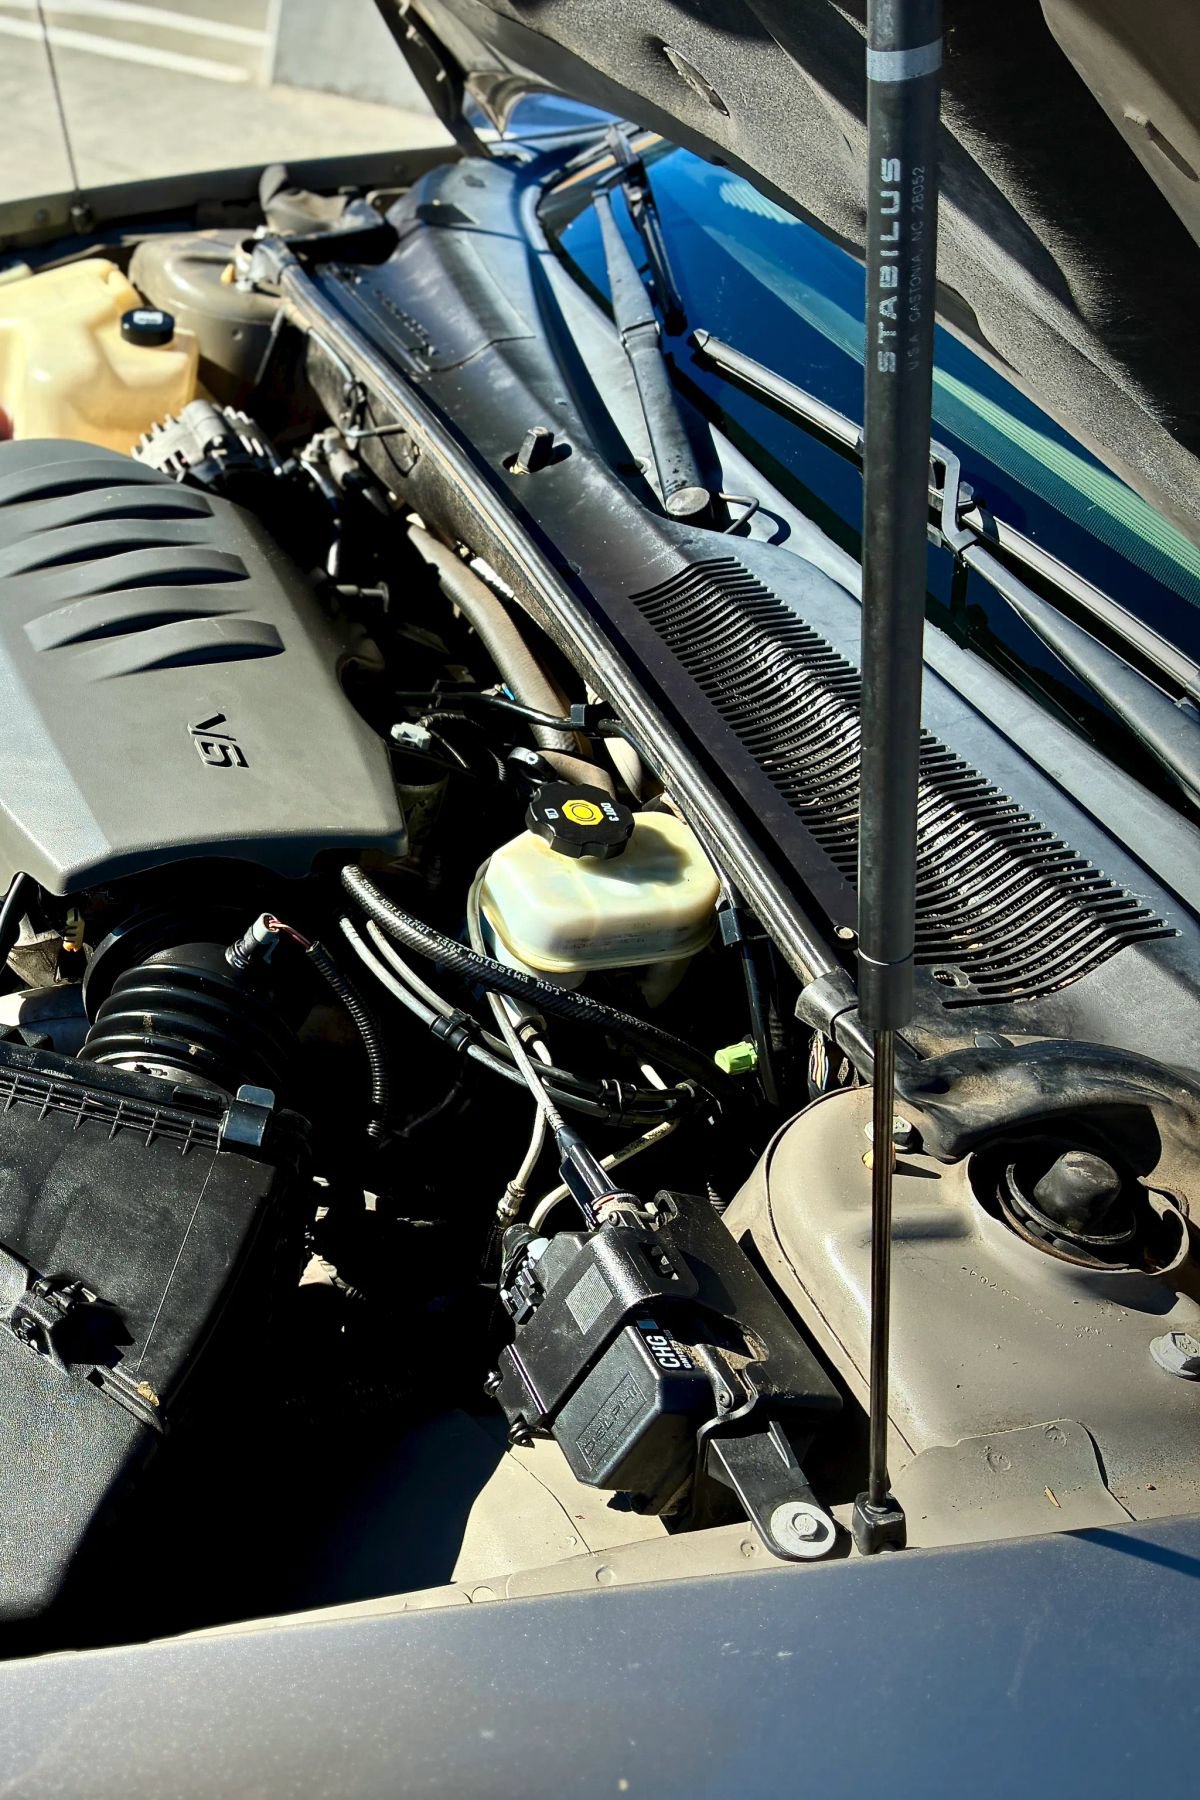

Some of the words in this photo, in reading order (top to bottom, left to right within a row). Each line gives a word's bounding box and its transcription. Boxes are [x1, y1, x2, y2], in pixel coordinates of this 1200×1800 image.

[911, 166, 926, 212] 28052
[878, 157, 902, 374] STABILUS
[187, 711, 250, 769] V6
[601, 802, 616, 818] DOT
[380, 898, 430, 935] INJECTION
[436, 935, 463, 953] FUEL
[467, 952, 529, 984] EMISSION
[536, 979, 561, 996] LOW
[645, 1335, 681, 1368] CHG
[584, 1388, 639, 1455] DELPHI
